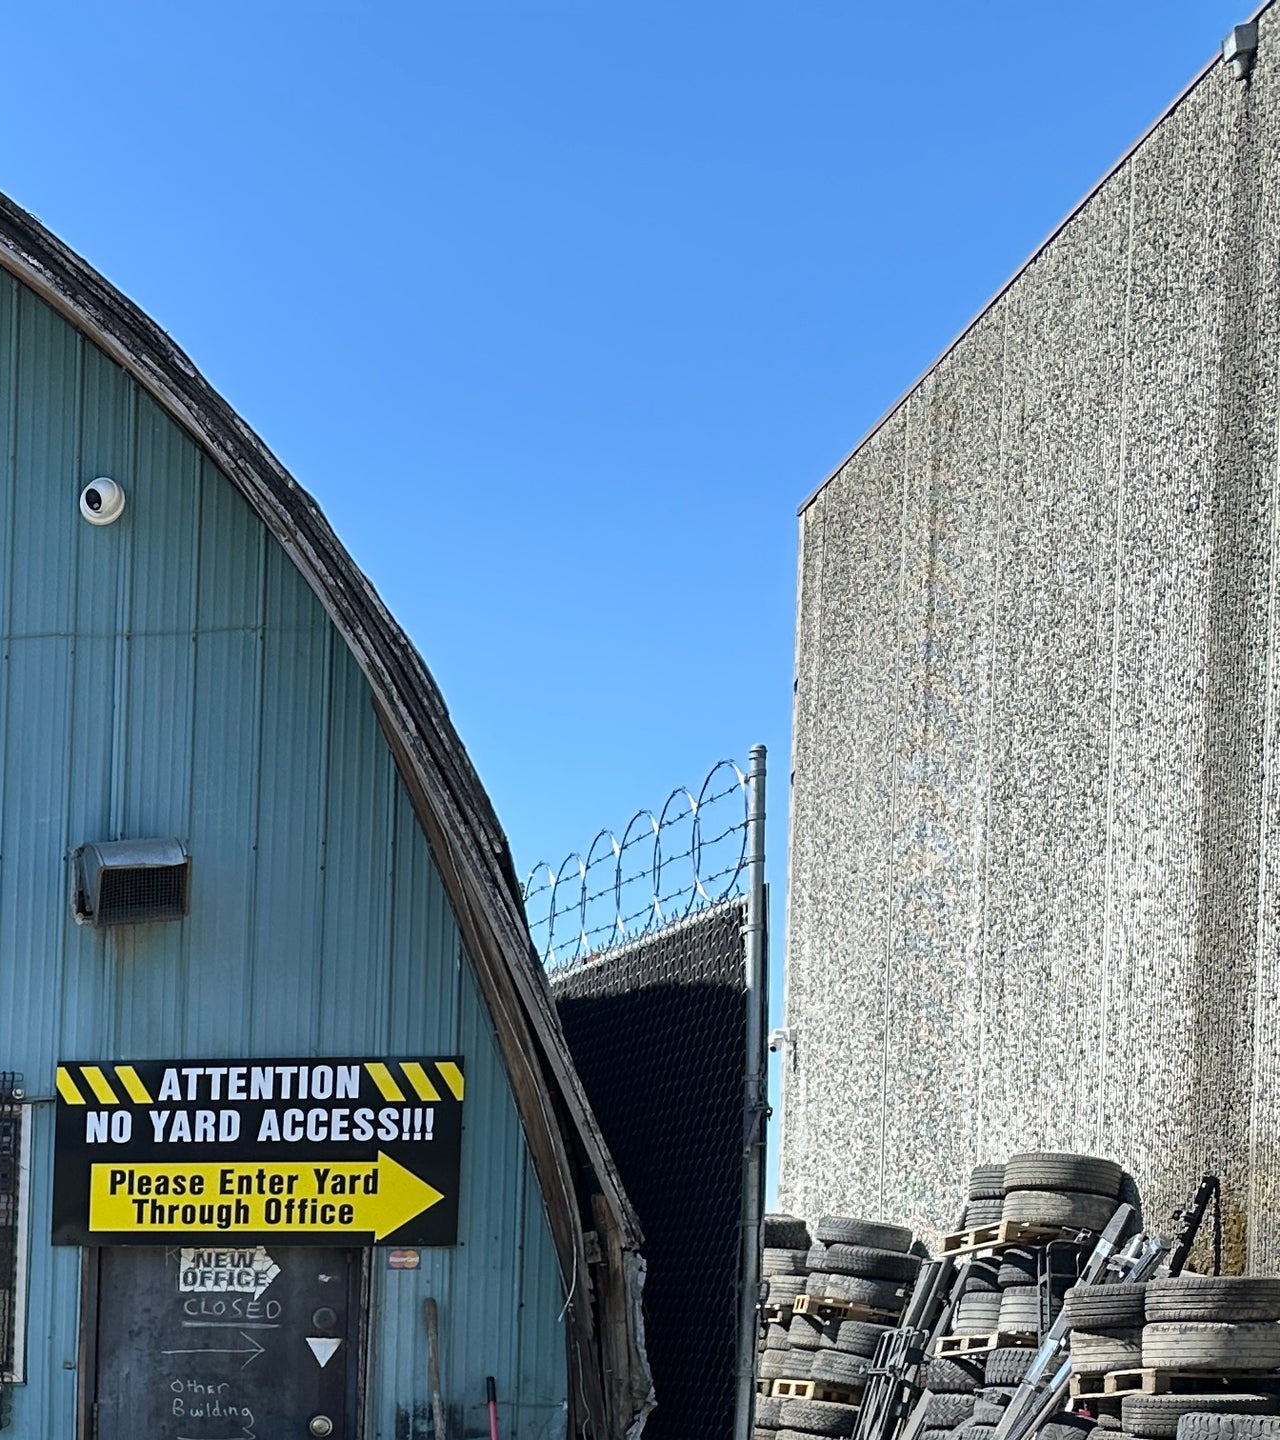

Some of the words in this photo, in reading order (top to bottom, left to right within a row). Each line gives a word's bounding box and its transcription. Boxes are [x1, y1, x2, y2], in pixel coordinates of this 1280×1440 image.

[157, 1065, 361, 1101] ATTENTION
[85, 1110, 133, 1144] NO
[149, 1109, 241, 1143] YARD
[257, 1107, 434, 1142] ACCESS!!!
[109, 1169, 205, 1196] Please
[219, 1168, 299, 1195] Enter
[313, 1168, 380, 1195] Yard
[132, 1198, 250, 1230] Through
[264, 1198, 354, 1225] Office
[194, 1250, 254, 1268] NEW
[182, 1267, 268, 1287] OFFICE
[183, 1298, 282, 1320] CLOSED
[170, 1379, 230, 1395] Other
[172, 1398, 255, 1429] Building
